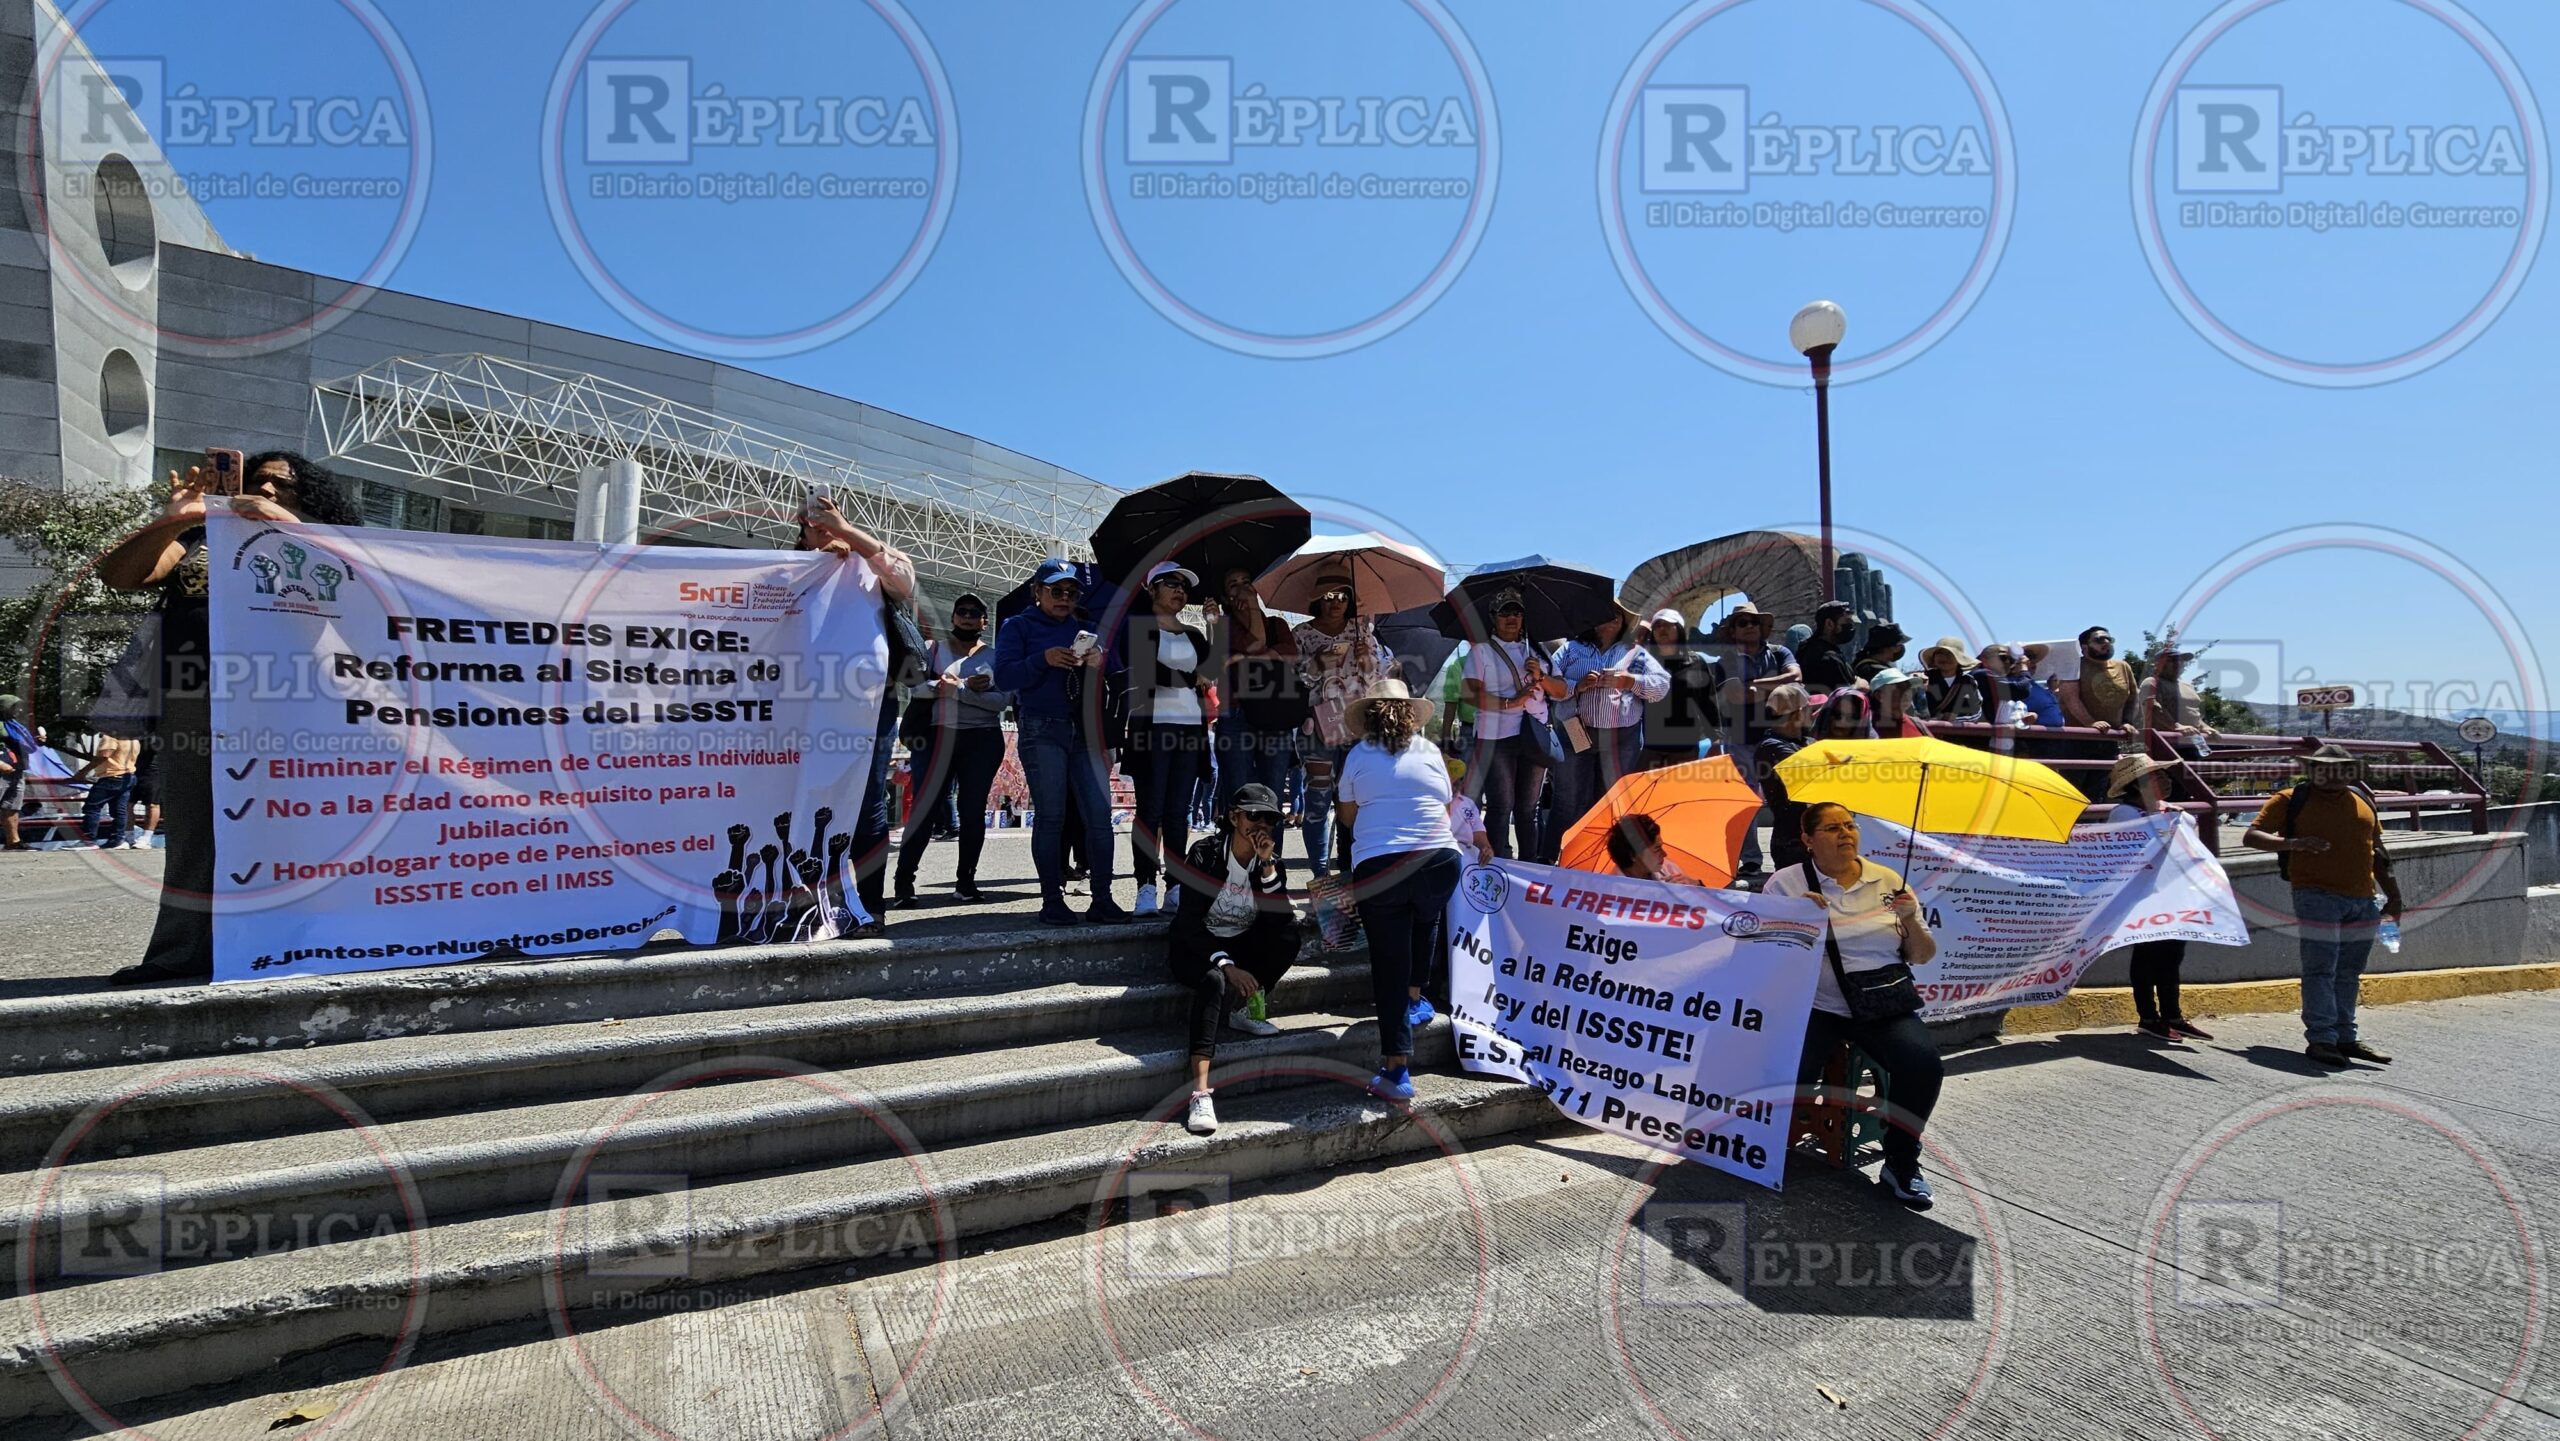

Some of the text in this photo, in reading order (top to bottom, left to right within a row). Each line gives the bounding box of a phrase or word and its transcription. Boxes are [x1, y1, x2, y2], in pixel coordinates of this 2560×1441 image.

[680, 582, 744, 604] SNTE
[387, 616, 750, 652] FRETEDES EXIGE:
[334, 652, 780, 685] Reforma al Sistema de
[346, 699, 773, 728] Pensiones del ISSSTE
[2299, 690, 2350, 705] OXXO
[268, 757, 397, 779] Eliminar
[404, 756, 429, 774] el
[439, 757, 553, 779] Régimen
[560, 754, 589, 771] de
[597, 752, 692, 769] Cuentas
[266, 782, 736, 818] No a la Edad como Requisito para la
[436, 817, 569, 846] Jubilación
[273, 835, 715, 881] Homologar tope de Pensiones del
[375, 870, 614, 905] ISSSTE con el IMSS
[1937, 884, 2049, 898] Pago Inmediato de
[1963, 897, 1992, 906] Pago
[1997, 898, 2008, 906] de
[2015, 899, 2055, 908] Marcha
[1525, 881, 1708, 930] EL FRETEDES
[2021, 908, 2031, 916] al
[250, 903, 678, 971] #JuntosPorNuestrosDerechos
[1565, 924, 1638, 964] Exige
[1977, 945, 2002, 953] Pago
[1500, 956, 1518, 977] a
[1524, 955, 1546, 983] la
[1552, 962, 1674, 1012] Reforma
[1683, 991, 1722, 1023] de
[1732, 1001, 1764, 1032] la
[1483, 982, 1695, 1062] ley del ISSSTE!
[1531, 1044, 1773, 1125] al Rezago Laboral!
[1601, 1096, 1768, 1171] Presente
